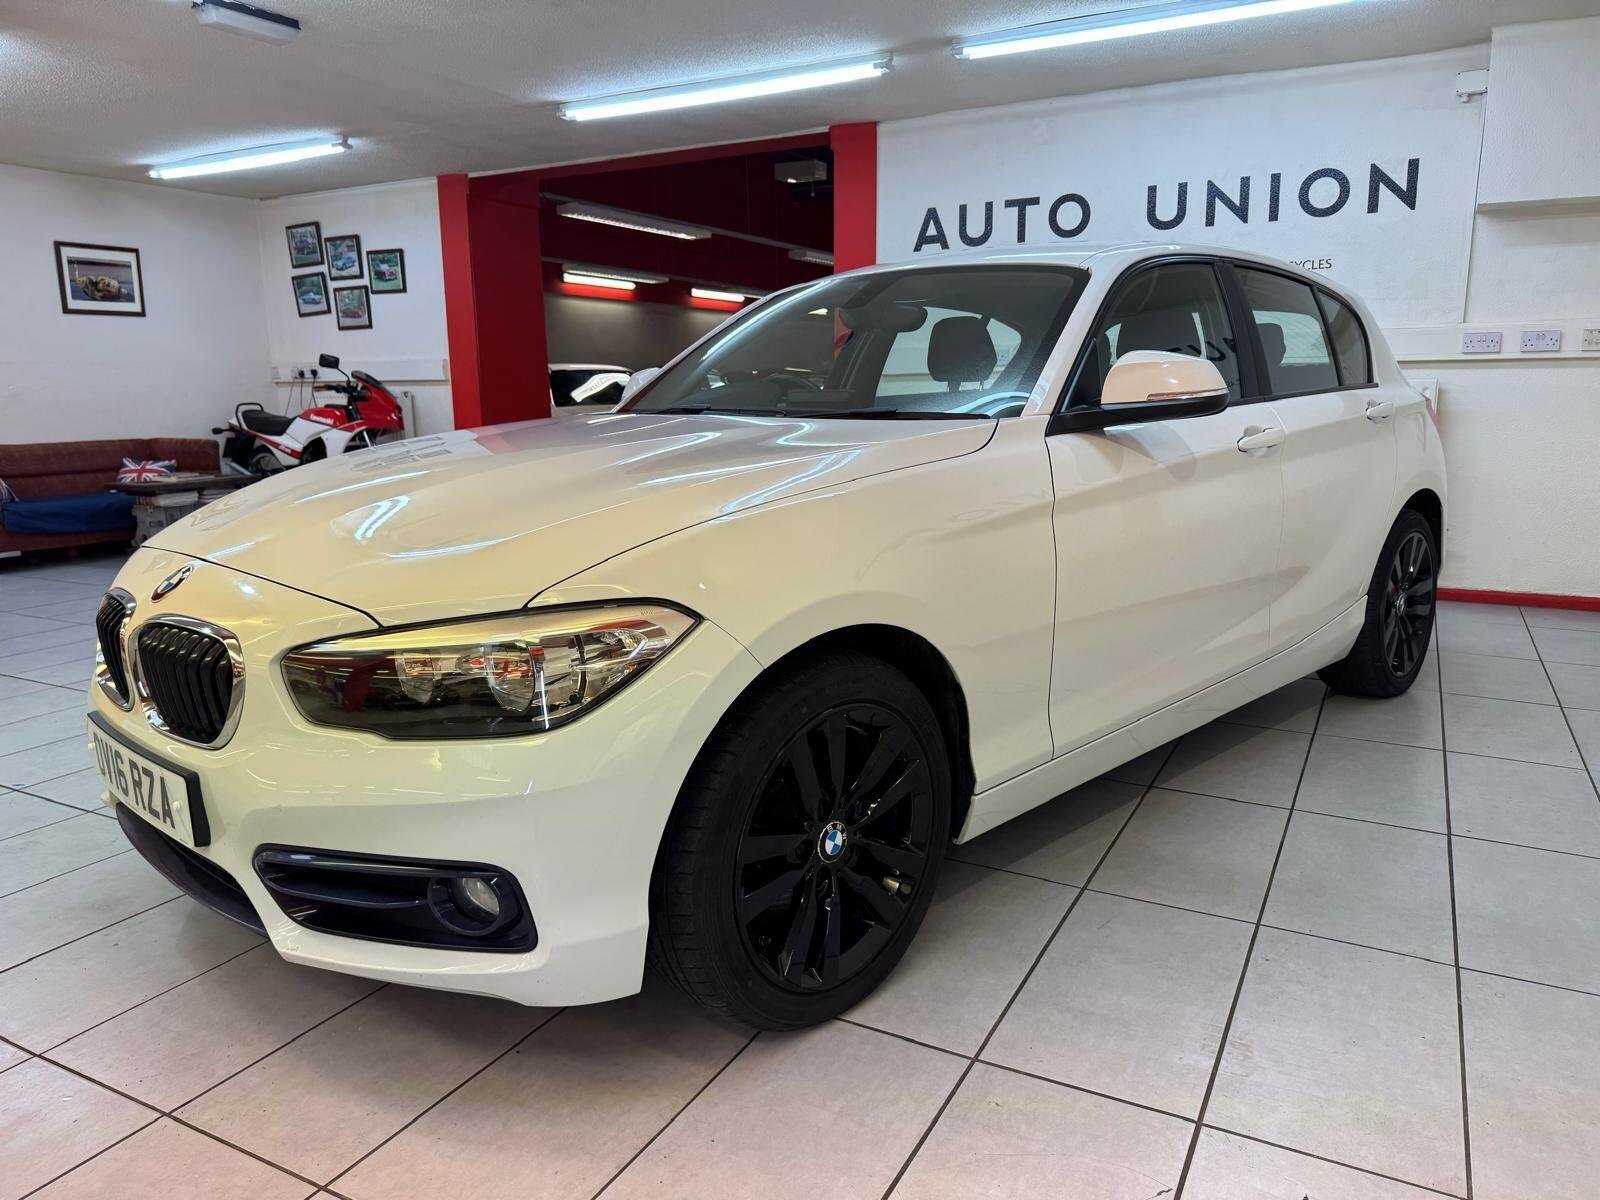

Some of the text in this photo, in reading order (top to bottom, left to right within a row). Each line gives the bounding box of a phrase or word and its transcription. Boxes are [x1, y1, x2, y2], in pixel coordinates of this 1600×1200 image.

[913, 158, 1421, 252] AUTO UNION
[128, 757, 176, 829] RZA
